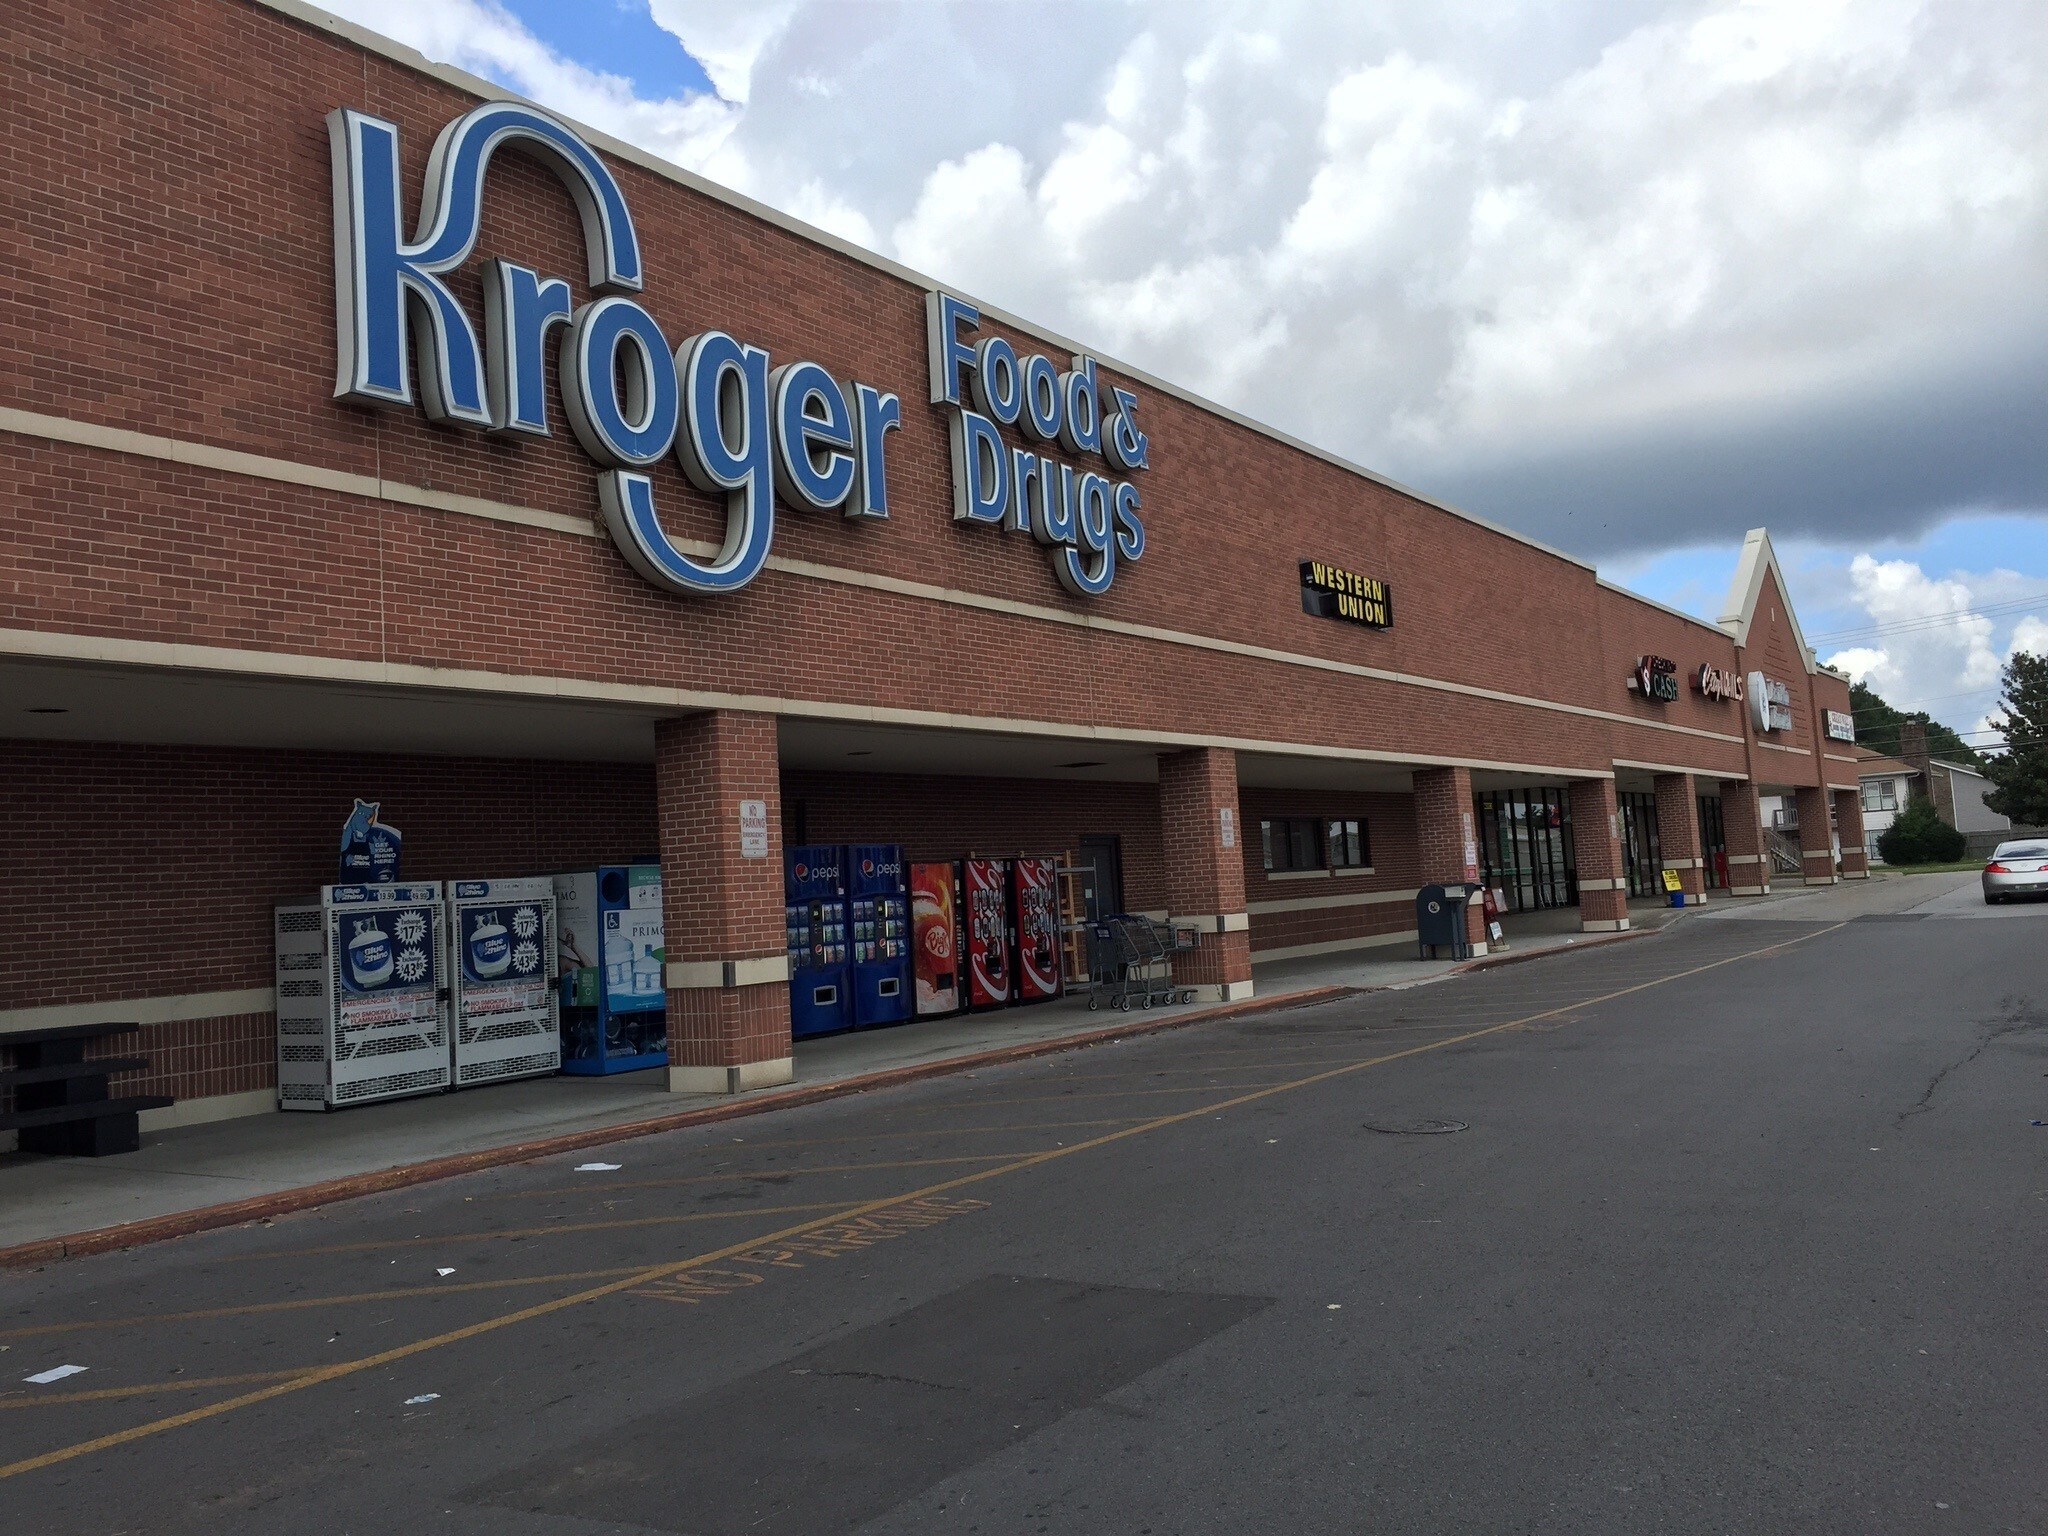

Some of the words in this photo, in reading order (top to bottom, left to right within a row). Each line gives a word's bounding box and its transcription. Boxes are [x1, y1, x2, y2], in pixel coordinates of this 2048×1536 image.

[328, 101, 900, 596] Kroger
[927, 291, 1100, 454] Food
[1102, 386, 1150, 471] &
[949, 409, 1146, 596] Drugs
[1312, 561, 1383, 602] WESTERN
[1338, 593, 1385, 625] UNION
[1653, 674, 1678, 701] CASH
[812, 864, 840, 881] pepsi
[556, 890, 577, 901] IMO
[364, 944, 384, 955] Blue
[485, 938, 504, 948] Blue
[624, 1269, 765, 1304] NO
